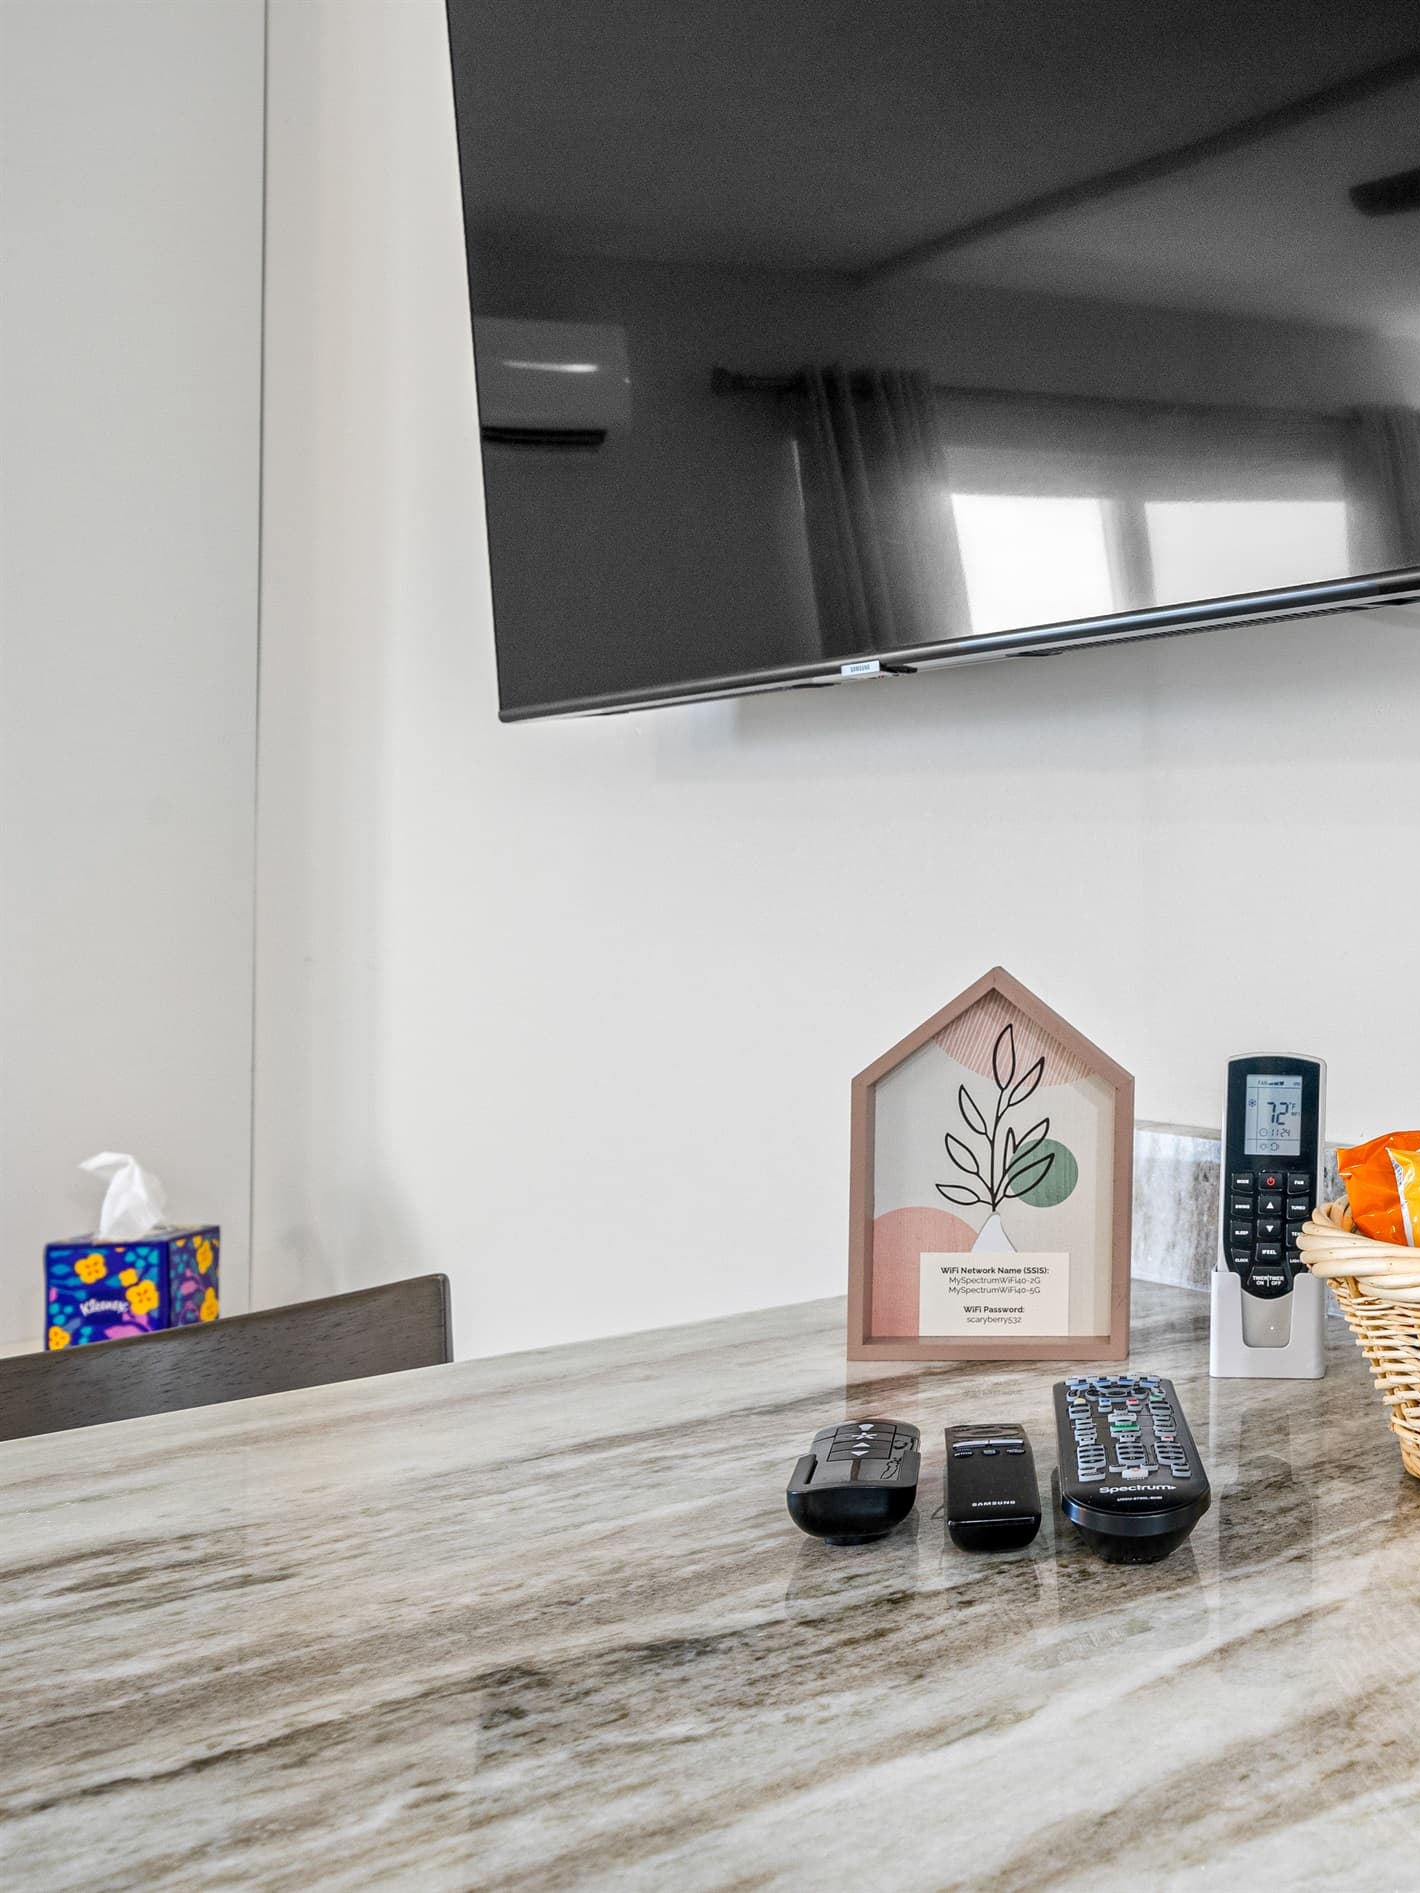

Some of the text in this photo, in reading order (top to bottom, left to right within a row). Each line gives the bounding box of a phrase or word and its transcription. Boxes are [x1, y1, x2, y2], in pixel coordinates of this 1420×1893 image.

[1267, 1102, 1289, 1125] 72
[941, 1266, 959, 1274] WiFi
[961, 1266, 996, 1274] Network
[80, 1299, 128, 1317] Kleenex
[983, 1306, 1025, 1314] Password:
[966, 1316, 1022, 1325] scaryberry532
[1099, 1484, 1171, 1495] Spectrum
